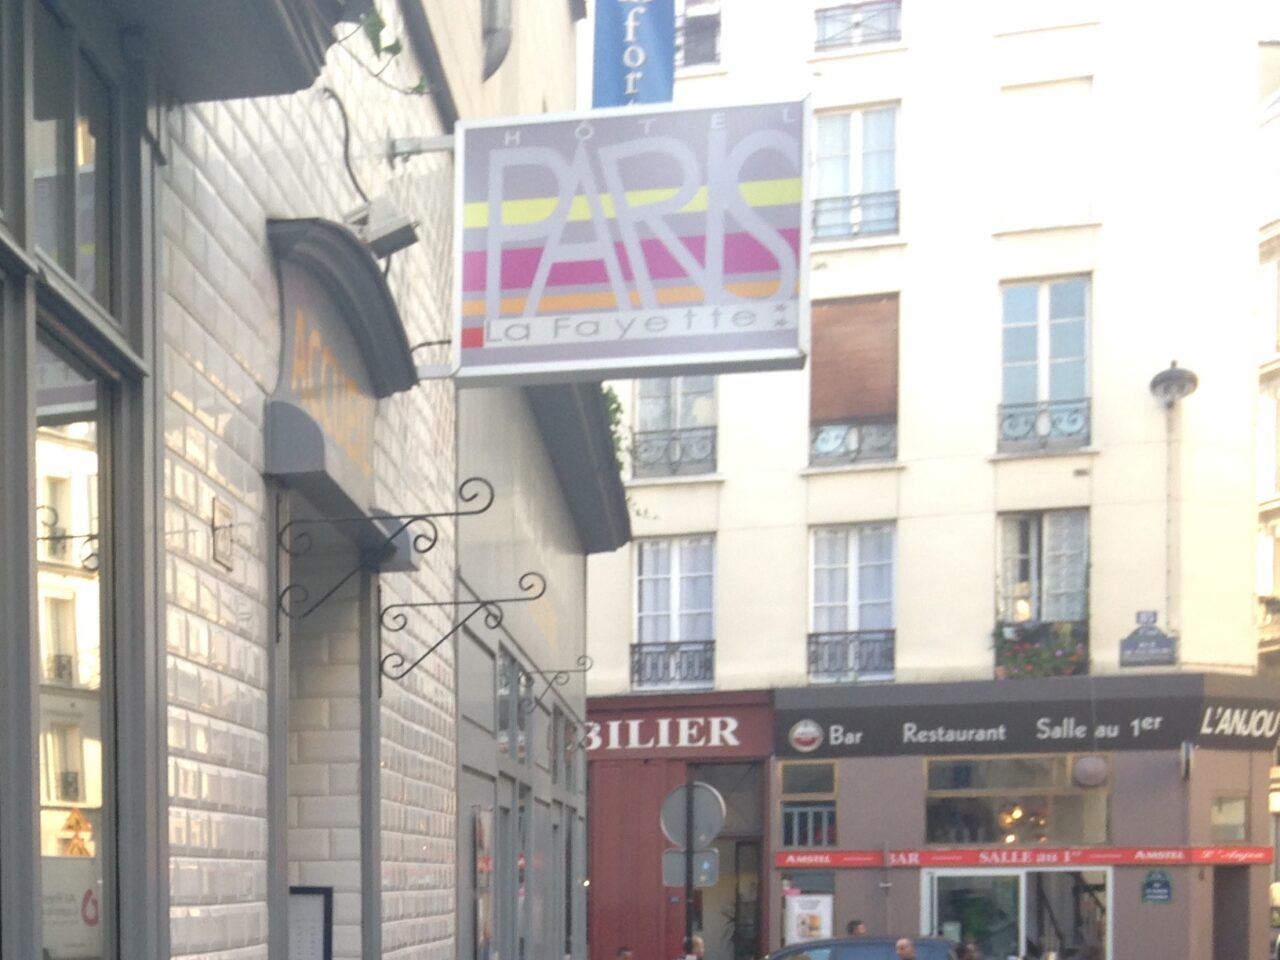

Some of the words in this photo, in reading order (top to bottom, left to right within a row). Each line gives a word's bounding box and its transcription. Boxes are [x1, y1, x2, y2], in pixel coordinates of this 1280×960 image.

[504, 107, 796, 146] HÔTEL
[484, 129, 800, 322] PARIS
[485, 319, 531, 343] La
[553, 308, 757, 339] Fayette
[829, 725, 863, 746] Bar
[902, 722, 1007, 744] Restaurant
[1036, 717, 1088, 740] Salle
[1094, 724, 1120, 739] au
[1130, 715, 1164, 738] 1er
[1200, 706, 1280, 737] L'ANJOU
[978, 850, 1033, 863] SALLE
